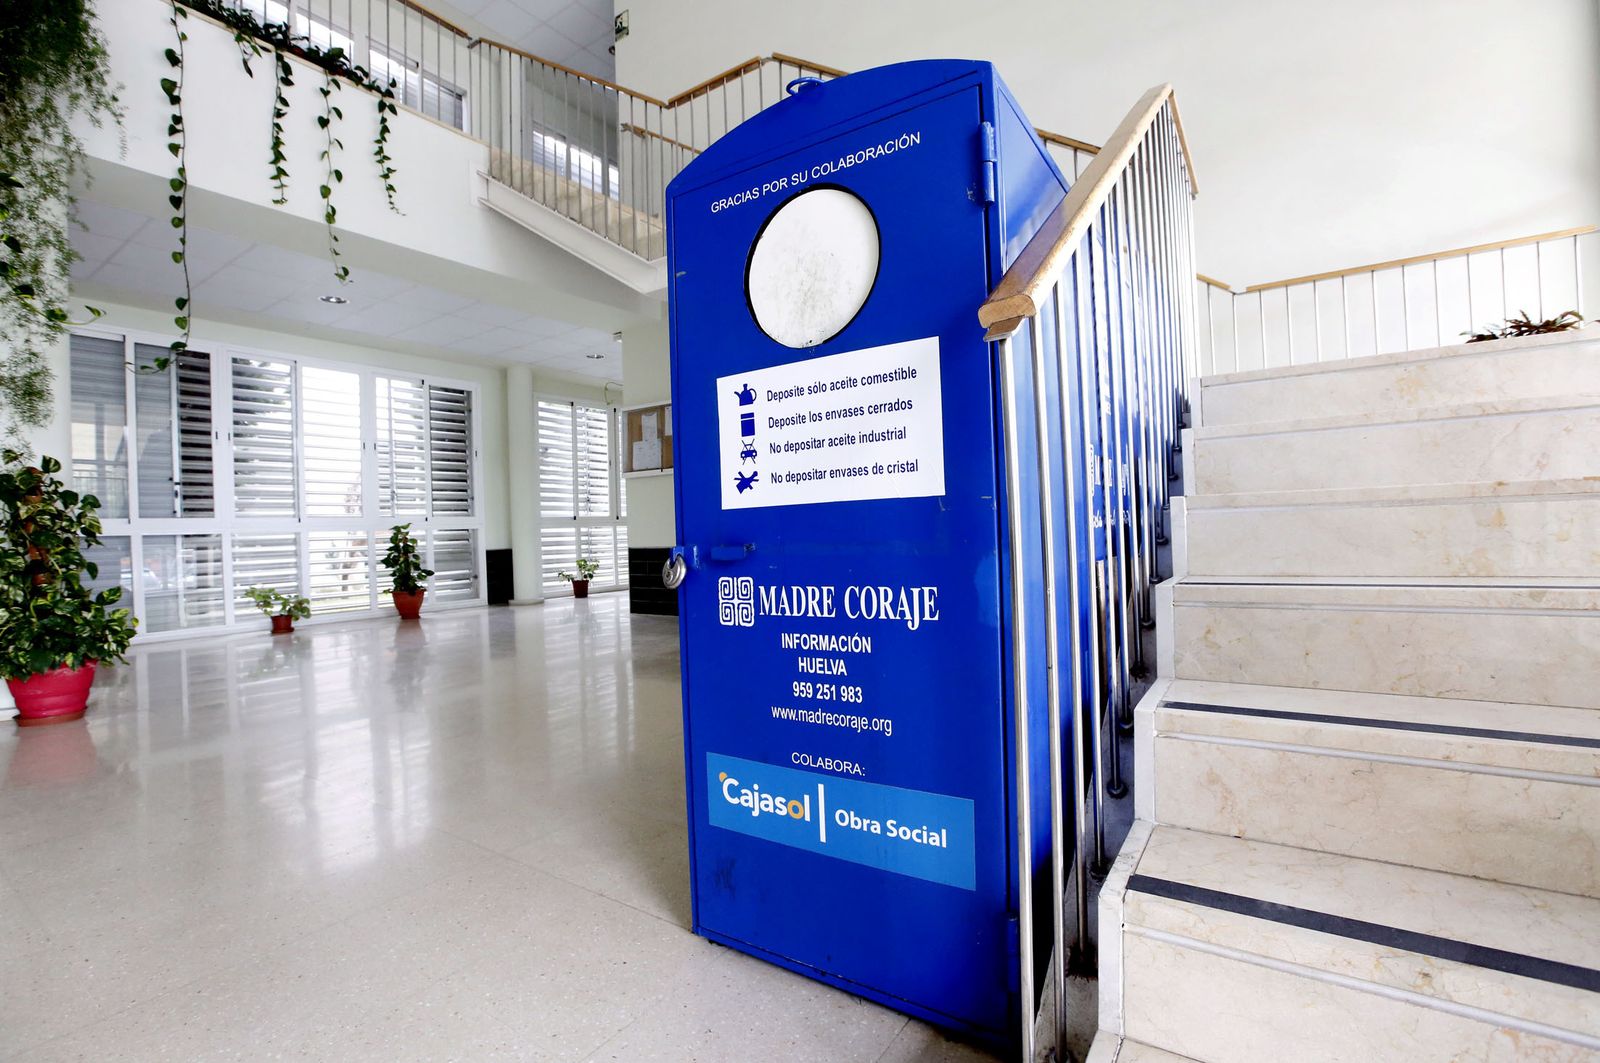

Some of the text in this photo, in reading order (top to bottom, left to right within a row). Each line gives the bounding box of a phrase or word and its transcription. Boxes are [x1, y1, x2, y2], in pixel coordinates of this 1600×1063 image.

[711, 132, 921, 213] GRACIAS POR SU COLABORACIÓN
[767, 366, 917, 403] Deposite sólo aceite comestible
[768, 398, 913, 429] Deposite los envases cerrados
[769, 426, 906, 454] No depositar aceite industrial
[770, 459, 919, 485] No depositar envases de cristal
[758, 585, 940, 631] MADRE CORAJE
[781, 632, 872, 654] INFORMACIÓN
[798, 656, 848, 676] HUELVA
[792, 681, 863, 704] 959 251 983
[771, 706, 892, 736] www.madrecoraje.org
[791, 752, 866, 776] COLABORA:
[719, 772, 811, 822] Cajasol
[835, 808, 947, 848] Obra Social
